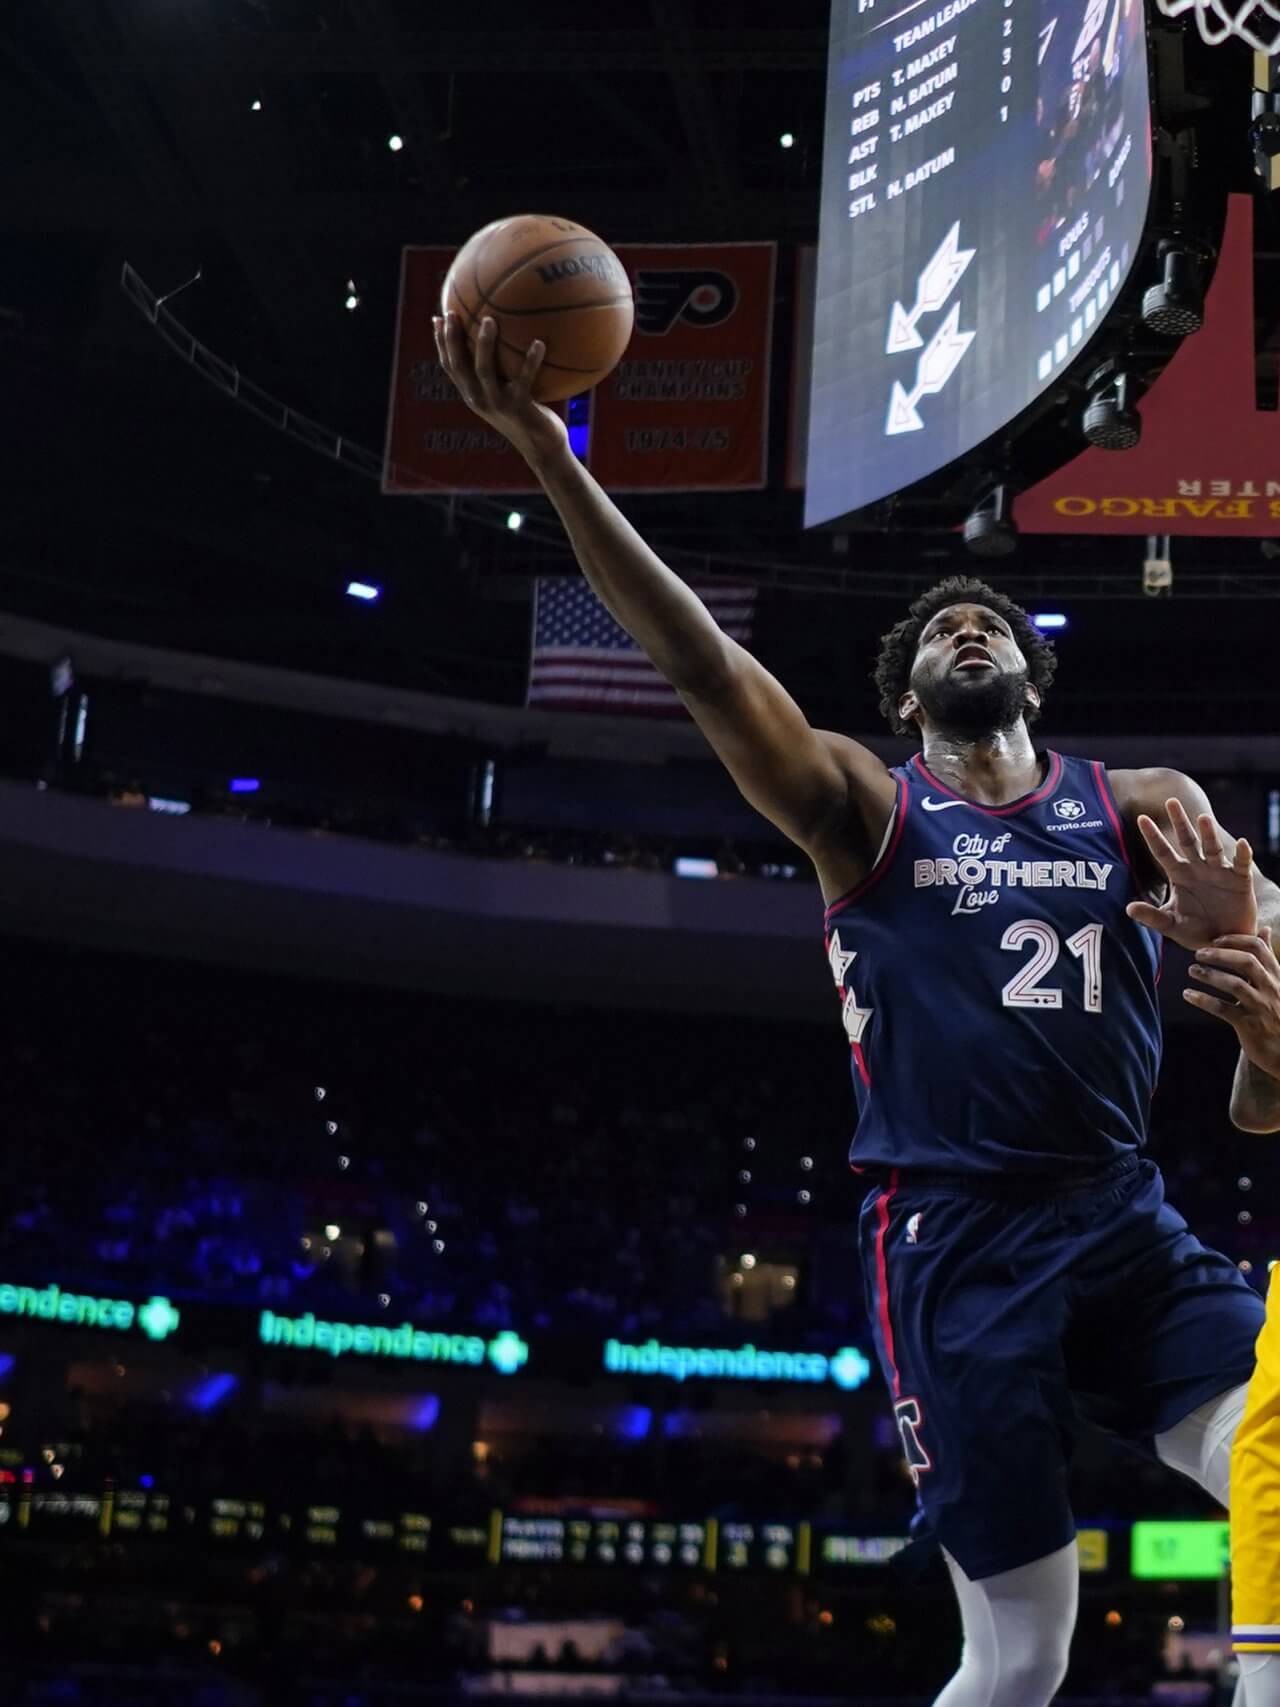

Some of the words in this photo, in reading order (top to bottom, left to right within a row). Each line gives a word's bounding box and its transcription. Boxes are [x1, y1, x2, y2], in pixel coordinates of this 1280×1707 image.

[893, 16, 935, 53] TEAM
[936, 0, 977, 28] LEAD
[851, 109, 879, 136] REB
[907, 62, 958, 109] BATUM
[1003, 19, 1012, 36] 2
[852, 81, 881, 108] PTS
[906, 36, 957, 80] MAXEY
[849, 137, 878, 164] AST
[905, 91, 955, 135] MAXEY
[1002, 48, 1011, 65] 3
[849, 165, 878, 191] BLK
[1001, 76, 1011, 94] 0
[848, 193, 877, 218] STL
[905, 147, 955, 192] BATUM
[1001, 105, 1008, 122] 1
[1055, 497, 1256, 519] FARGO
[953, 833, 989, 861] City
[990, 832, 1012, 853] of
[1046, 819, 1103, 832] crypto.com
[914, 857, 1112, 890] BROTHERLY
[951, 885, 1000, 916] Love
[1000, 919, 1104, 1014] 21
[259, 1310, 486, 1366] Independence
[604, 1337, 828, 1383] Independence
